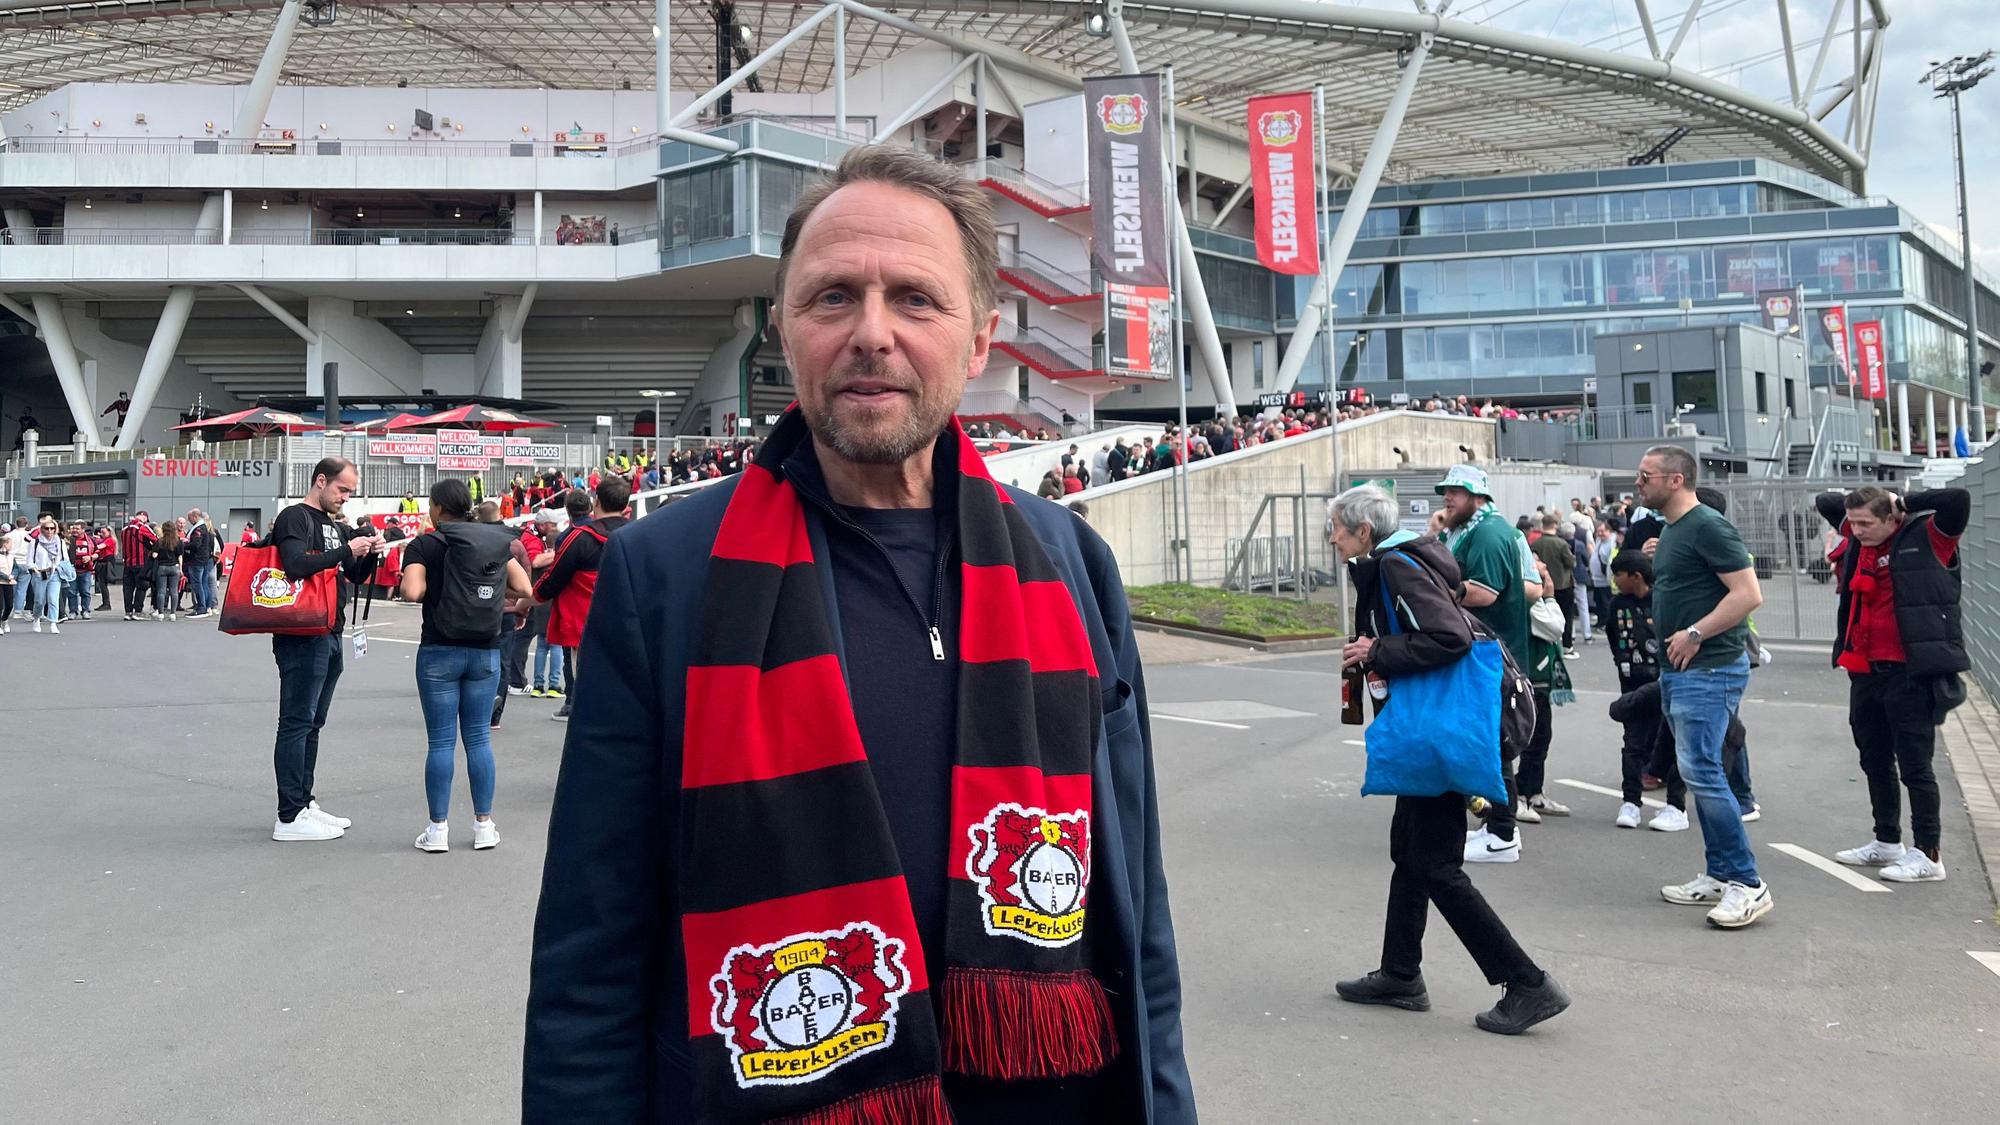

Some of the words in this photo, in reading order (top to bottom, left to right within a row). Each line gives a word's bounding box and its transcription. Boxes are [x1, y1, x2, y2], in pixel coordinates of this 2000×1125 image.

[282, 130, 294, 140] E4
[1260, 394, 1287, 406] WEST
[440, 431, 477, 443] WELKOM
[371, 442, 434, 454] WILLKOMMEN
[439, 445, 482, 456] WELCOME
[506, 446, 559, 457] BIENVENIDOS
[439, 456, 488, 468] BEM-VINDO
[142, 460, 219, 477] SERVICE
[225, 460, 274, 477] WEST
[1000, 910, 1084, 936] Leverkuse
[779, 947, 821, 967] 1904
[770, 992, 846, 1023] BAYER
[799, 971, 819, 1044] BAYER
[750, 1027, 879, 1074] Leverkusen
